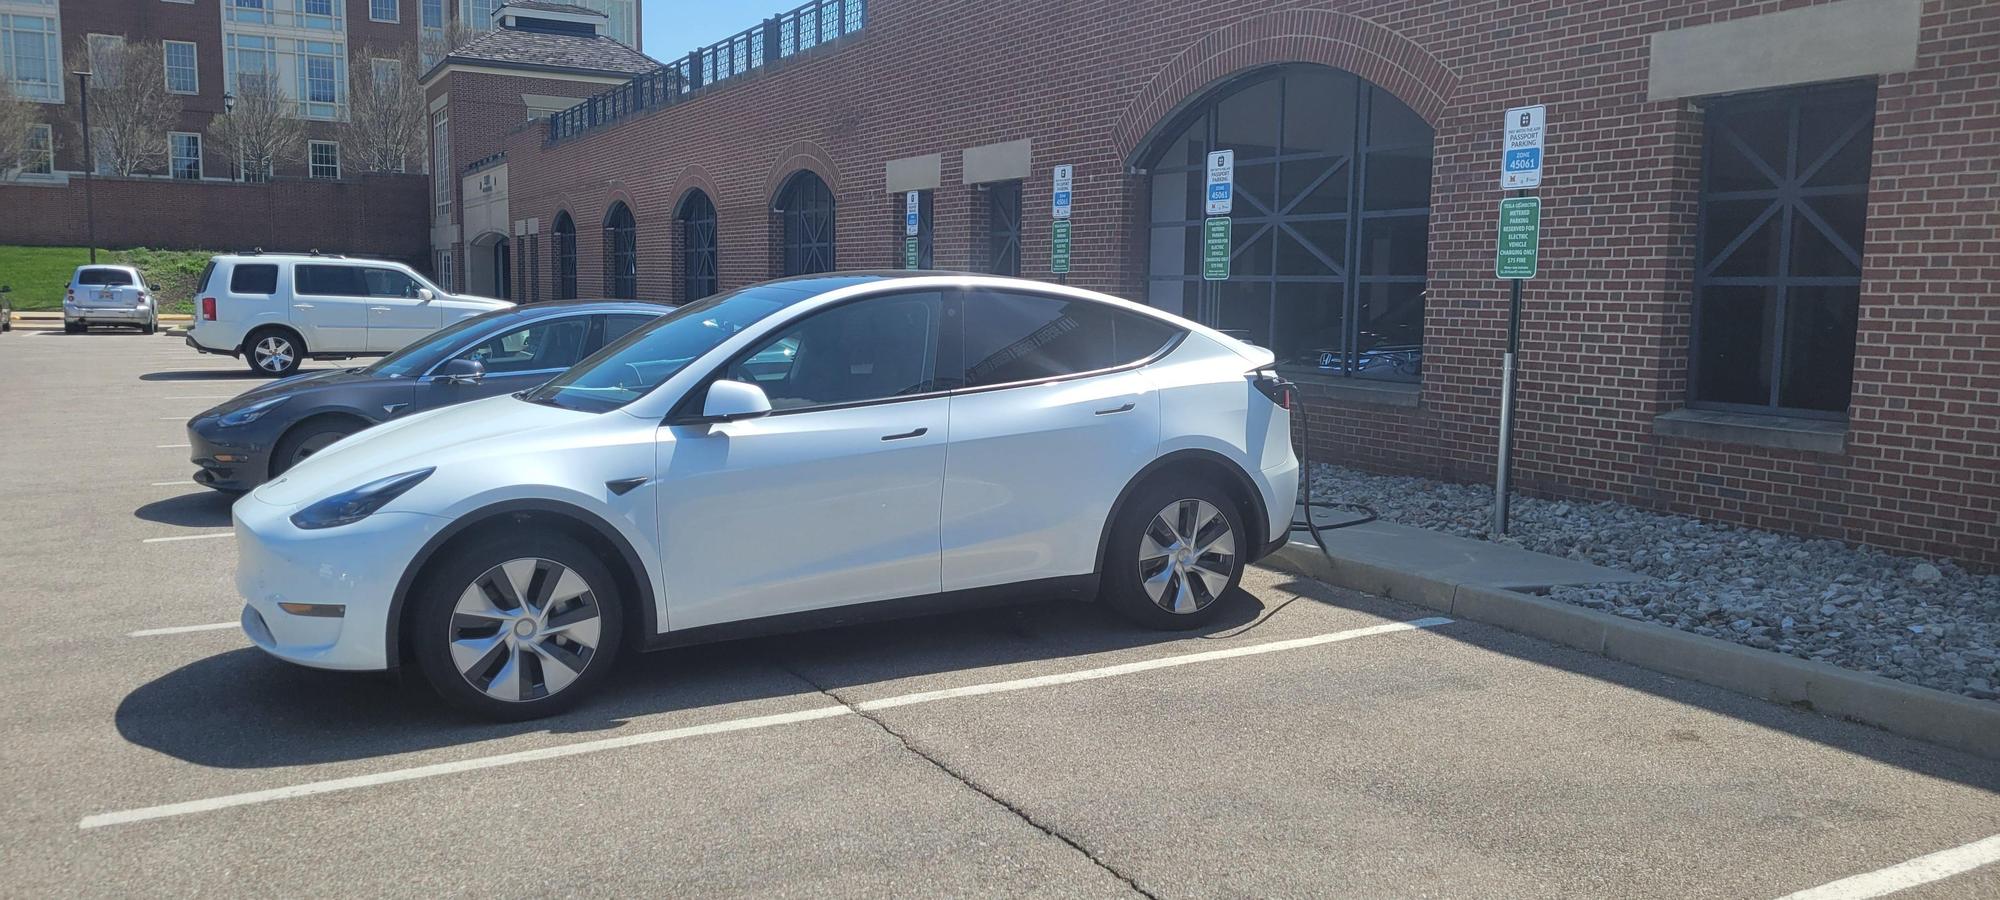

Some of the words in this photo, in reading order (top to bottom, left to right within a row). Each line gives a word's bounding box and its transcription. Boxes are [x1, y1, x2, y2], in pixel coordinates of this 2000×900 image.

[1510, 133, 1538, 141] PASSPORT
[1511, 140, 1536, 148] PARKING
[1510, 159, 1535, 169] 45061
